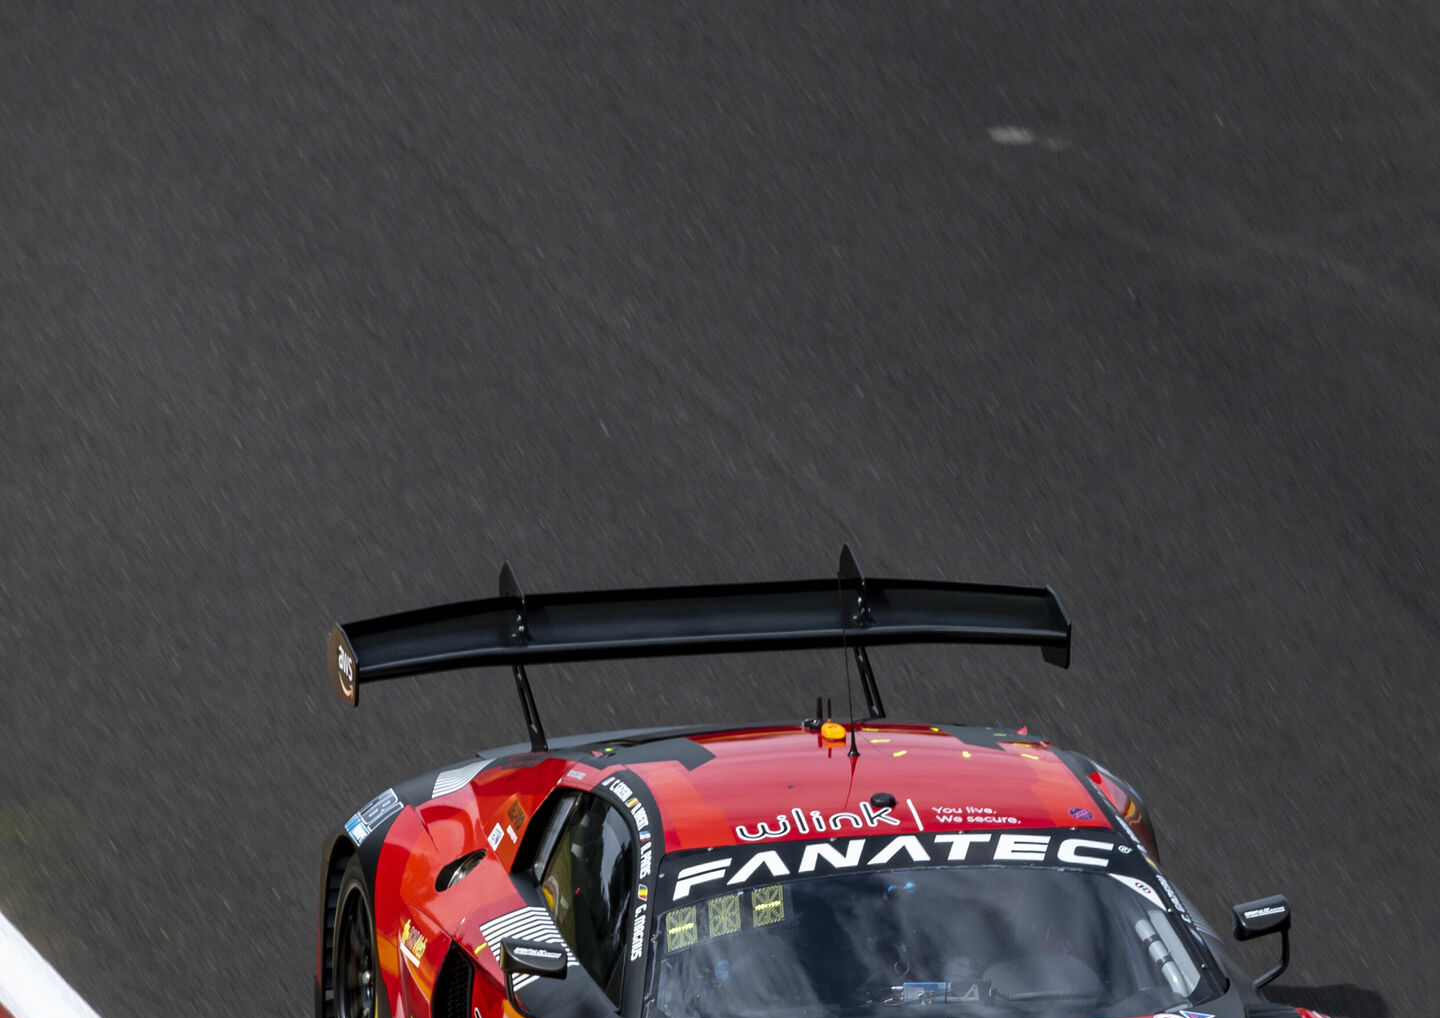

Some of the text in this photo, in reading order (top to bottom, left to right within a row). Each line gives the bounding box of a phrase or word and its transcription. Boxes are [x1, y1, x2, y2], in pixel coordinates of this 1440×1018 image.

[338, 645, 353, 681] aws
[736, 801, 900, 841] wlink
[931, 806, 997, 815] You live.
[935, 815, 1022, 825] We secure.
[672, 833, 1114, 901] FANATEC
